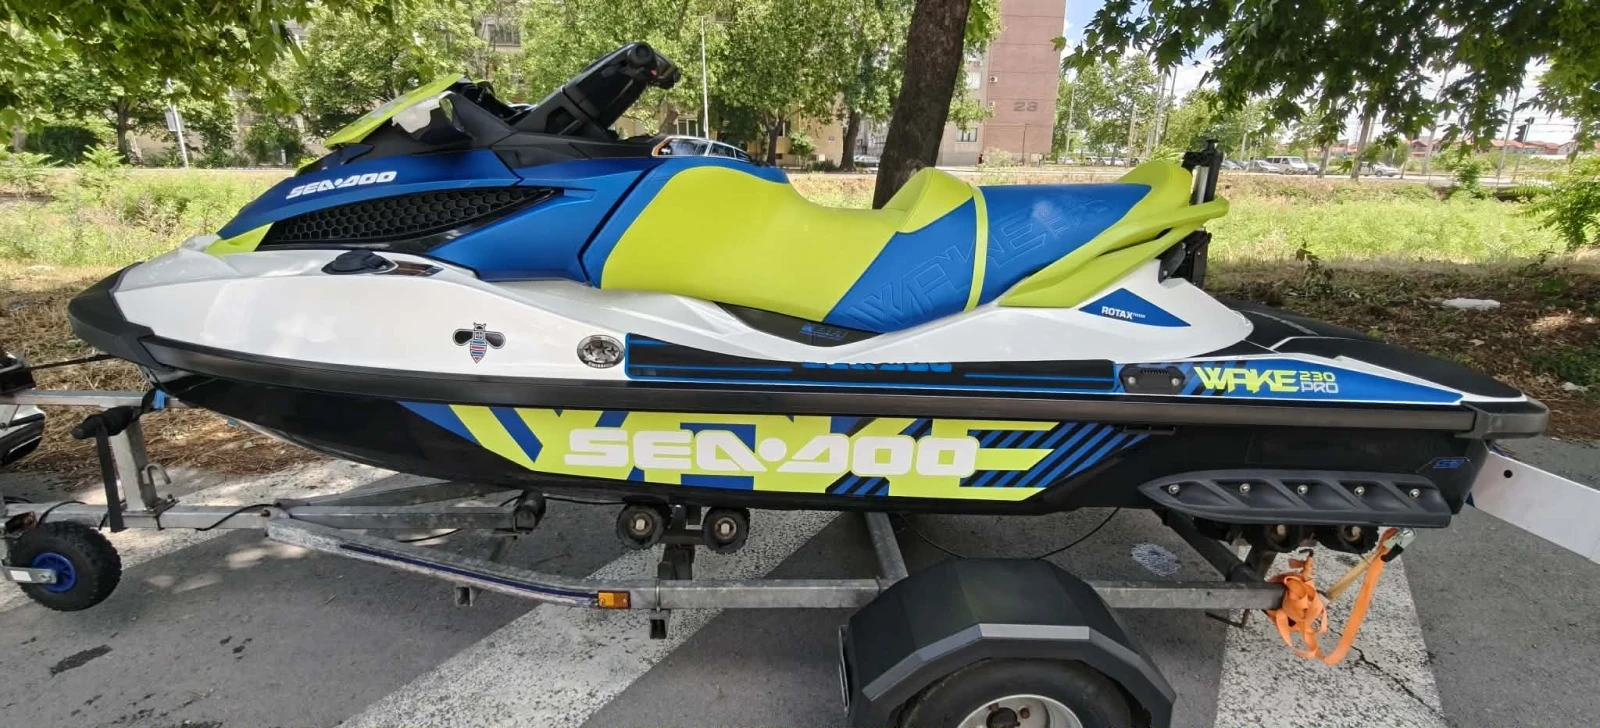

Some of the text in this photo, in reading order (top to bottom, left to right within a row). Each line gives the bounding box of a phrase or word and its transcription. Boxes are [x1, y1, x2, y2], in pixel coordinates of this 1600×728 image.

[1101, 306, 1133, 319] ROTAX
[1194, 367, 1335, 393] WAKE 230
[1301, 381, 1339, 394] PRO
